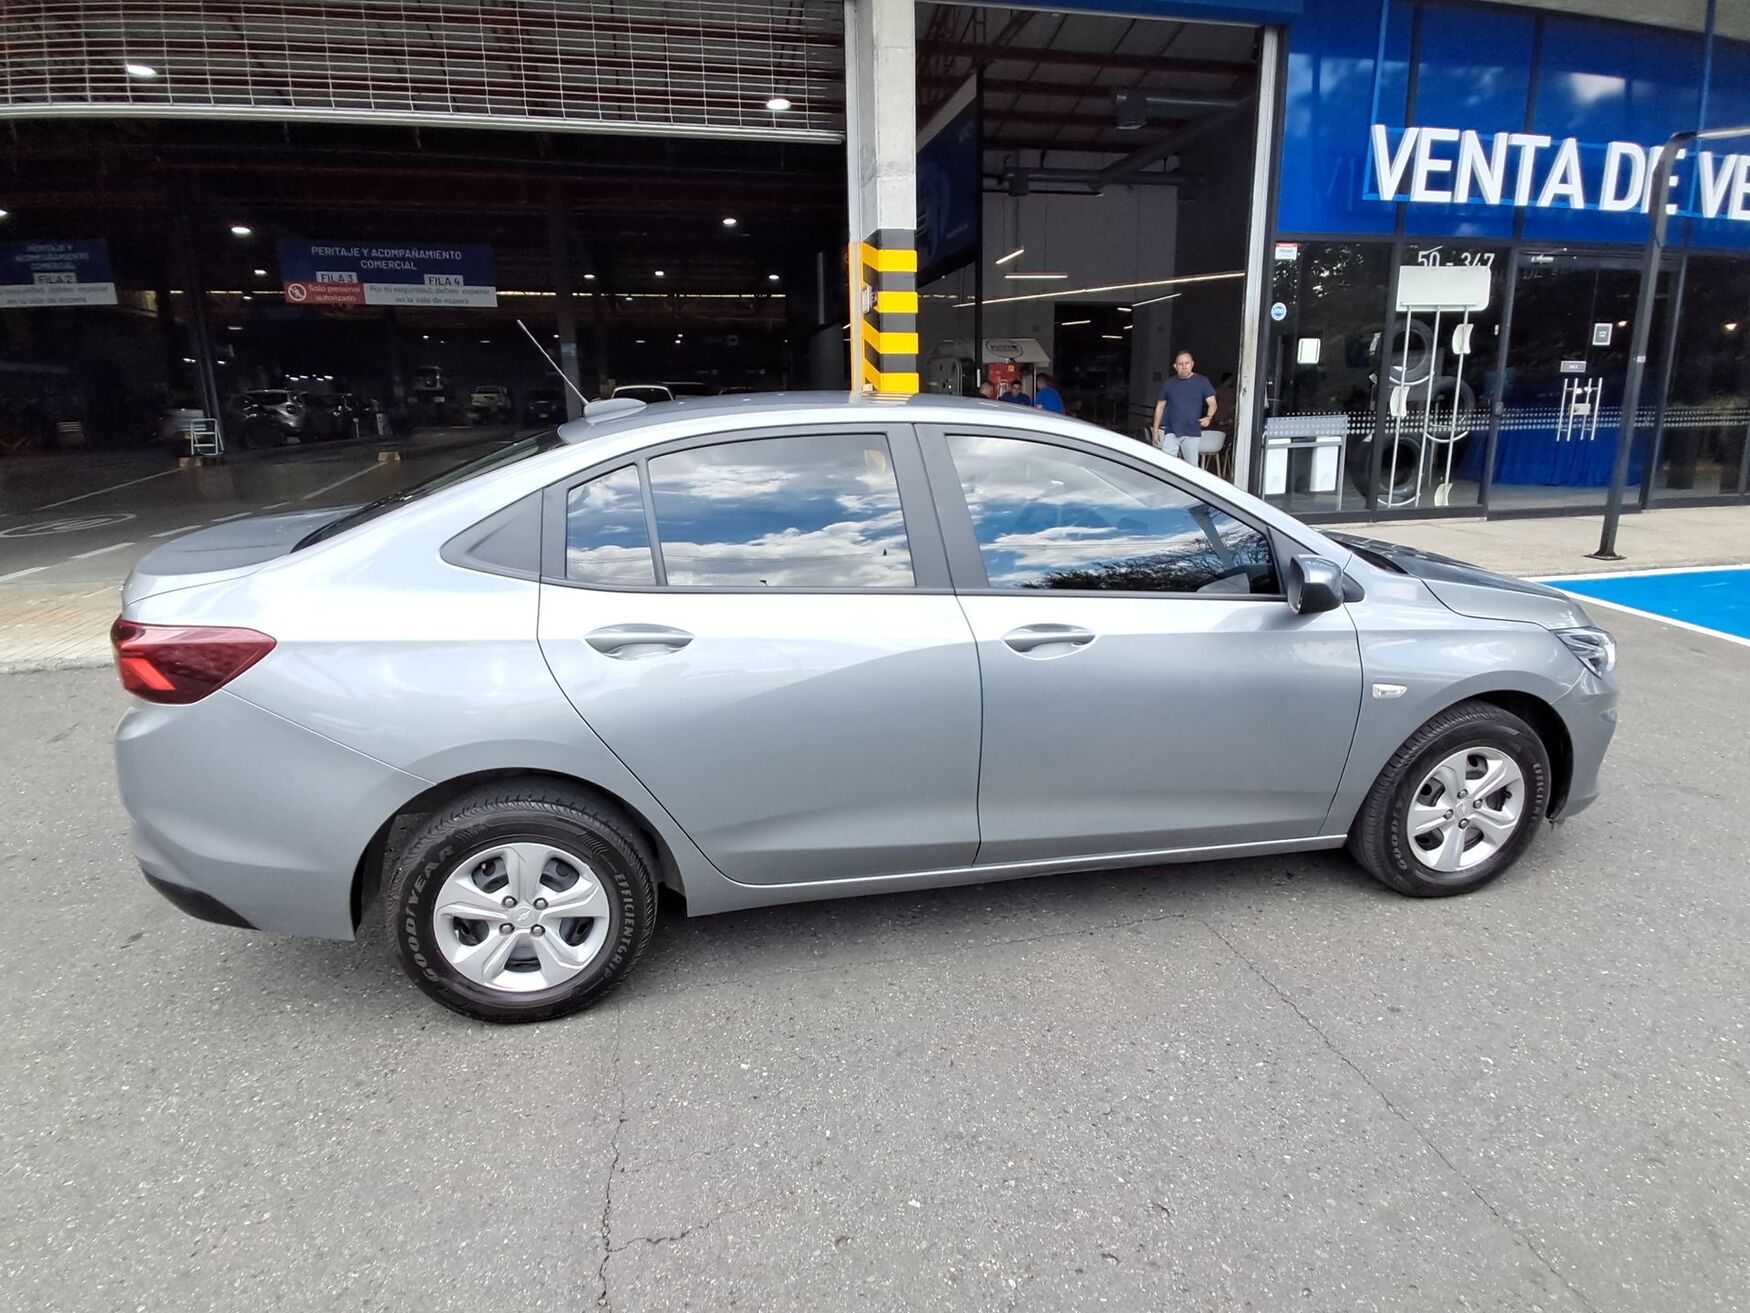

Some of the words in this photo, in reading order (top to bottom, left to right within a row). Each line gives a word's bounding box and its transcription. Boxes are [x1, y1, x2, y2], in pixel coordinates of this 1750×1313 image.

[1371, 124, 1584, 209] VENTA
[310, 246, 360, 257] PERITAJE
[361, 247, 370, 257] Y
[371, 247, 462, 260] ACOMPAÑAMIENTO
[360, 259, 418, 270] COMERCIAL
[320, 273, 345, 283] FILA
[347, 273, 355, 282] 3
[428, 276, 453, 286] FILA
[454, 277, 461, 285] 4
[405, 845, 454, 982] GOODYEAR
[604, 873, 635, 978] EFFICIENTGRIP
